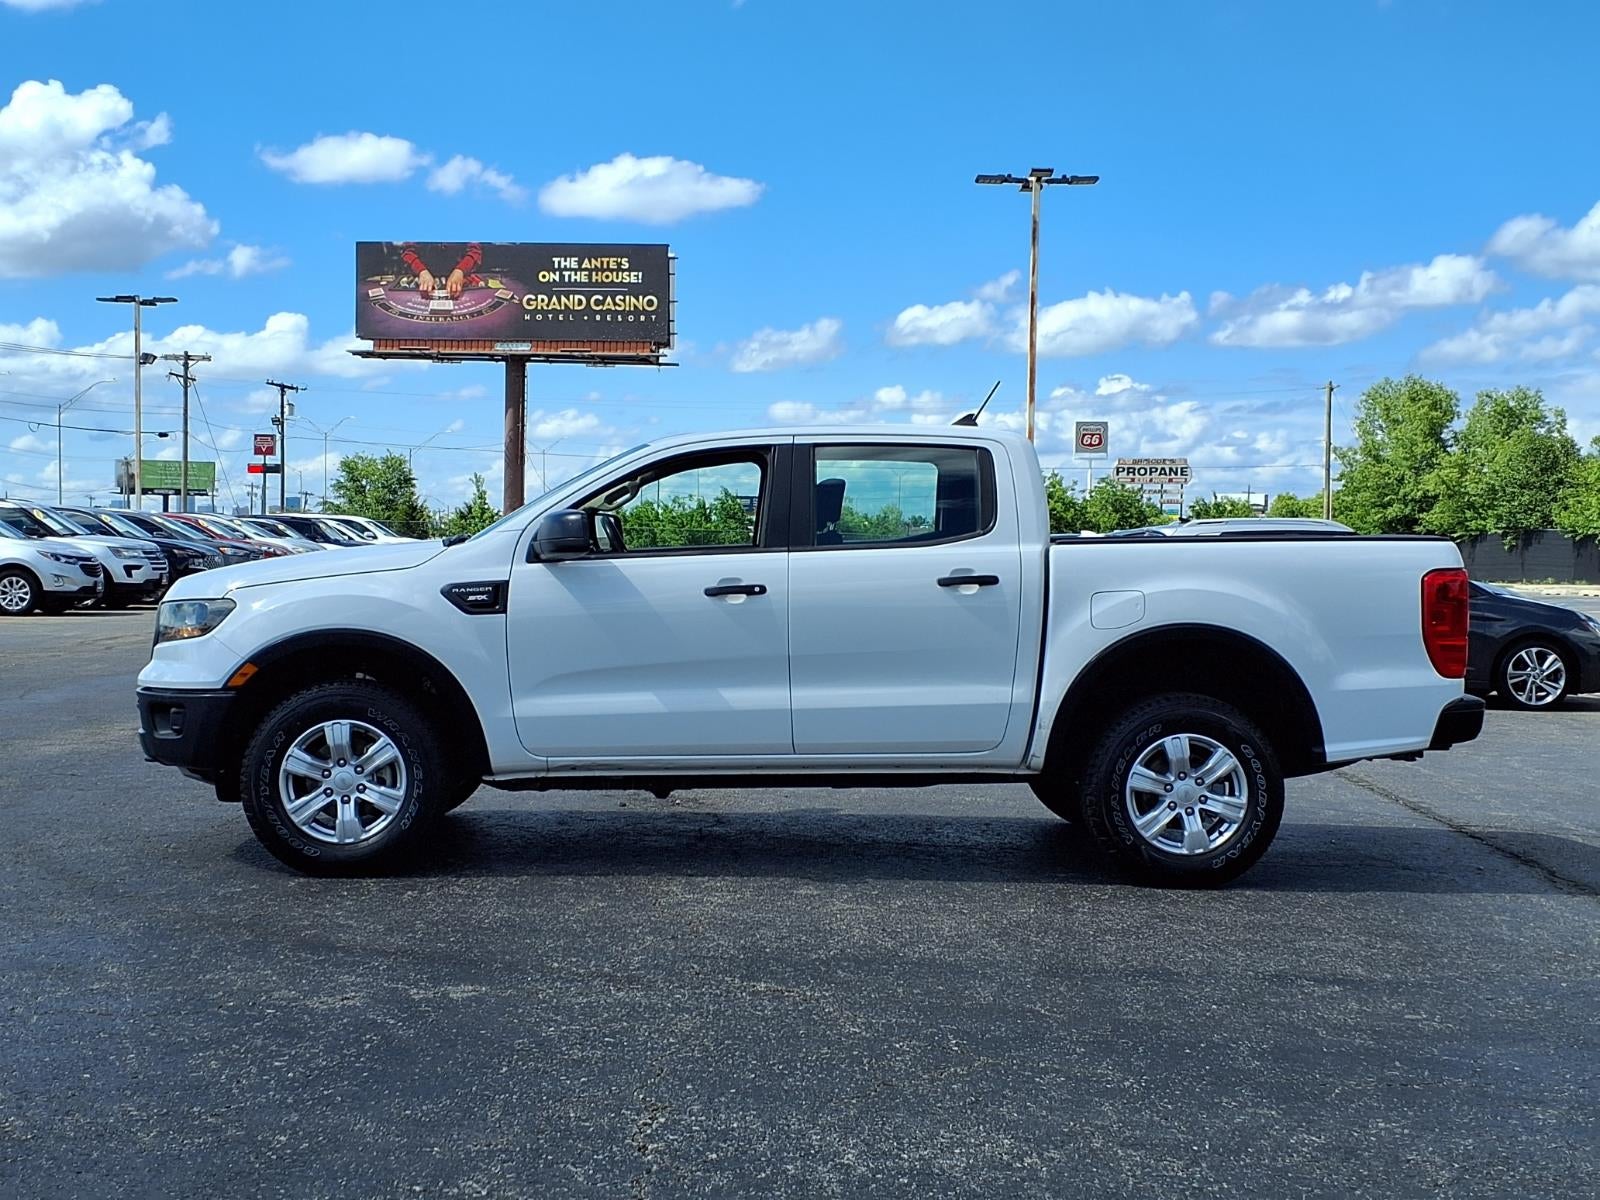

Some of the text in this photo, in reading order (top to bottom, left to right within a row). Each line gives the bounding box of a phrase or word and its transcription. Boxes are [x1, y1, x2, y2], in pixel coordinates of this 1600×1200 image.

[552, 257, 630, 270] THE ANTE'S
[538, 271, 643, 283] ON THE HOUSE!
[522, 294, 658, 311] GRAND CASINO
[524, 313, 657, 322] HOTEL RESORT
[1083, 434, 1100, 445] 66
[1116, 466, 1189, 477] PROPANE
[1212, 744, 1268, 869] GOODYEAR
